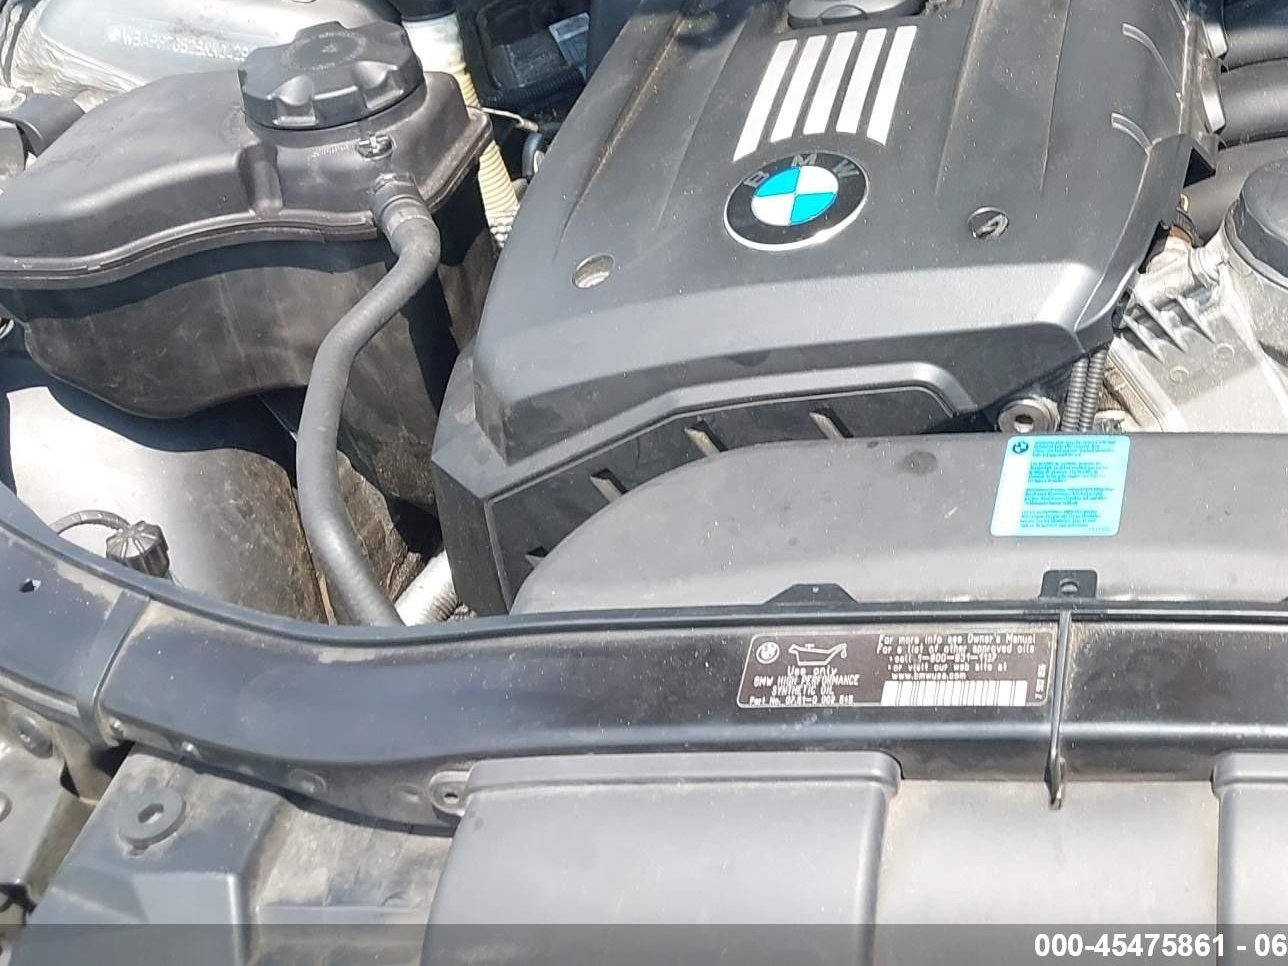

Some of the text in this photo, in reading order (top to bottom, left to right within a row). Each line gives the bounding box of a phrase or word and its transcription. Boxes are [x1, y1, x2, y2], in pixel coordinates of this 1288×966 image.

[743, 152, 860, 188] BMW
[878, 633, 894, 644] For
[898, 635, 919, 644] more
[925, 633, 943, 644] info
[967, 633, 1001, 644] Owner's
[1005, 633, 1036, 644] Manual
[876, 643, 892, 654] For
[907, 643, 924, 654] list
[928, 643, 940, 653] of
[944, 643, 967, 653] other
[972, 643, 1012, 654] approved
[1017, 644, 1035, 653] oils
[787, 665, 838, 677] Use only
[907, 663, 928, 671] visit
[953, 662, 970, 671] web
[975, 662, 993, 671] site
[997, 662, 1007, 671] at
[754, 674, 860, 687] BMW HIGH PERFORMANCE
[891, 671, 967, 681] www.bmwusa.com
[771, 684, 834, 696] SYNTHETIC OIL
[749, 696, 766, 706] Part
